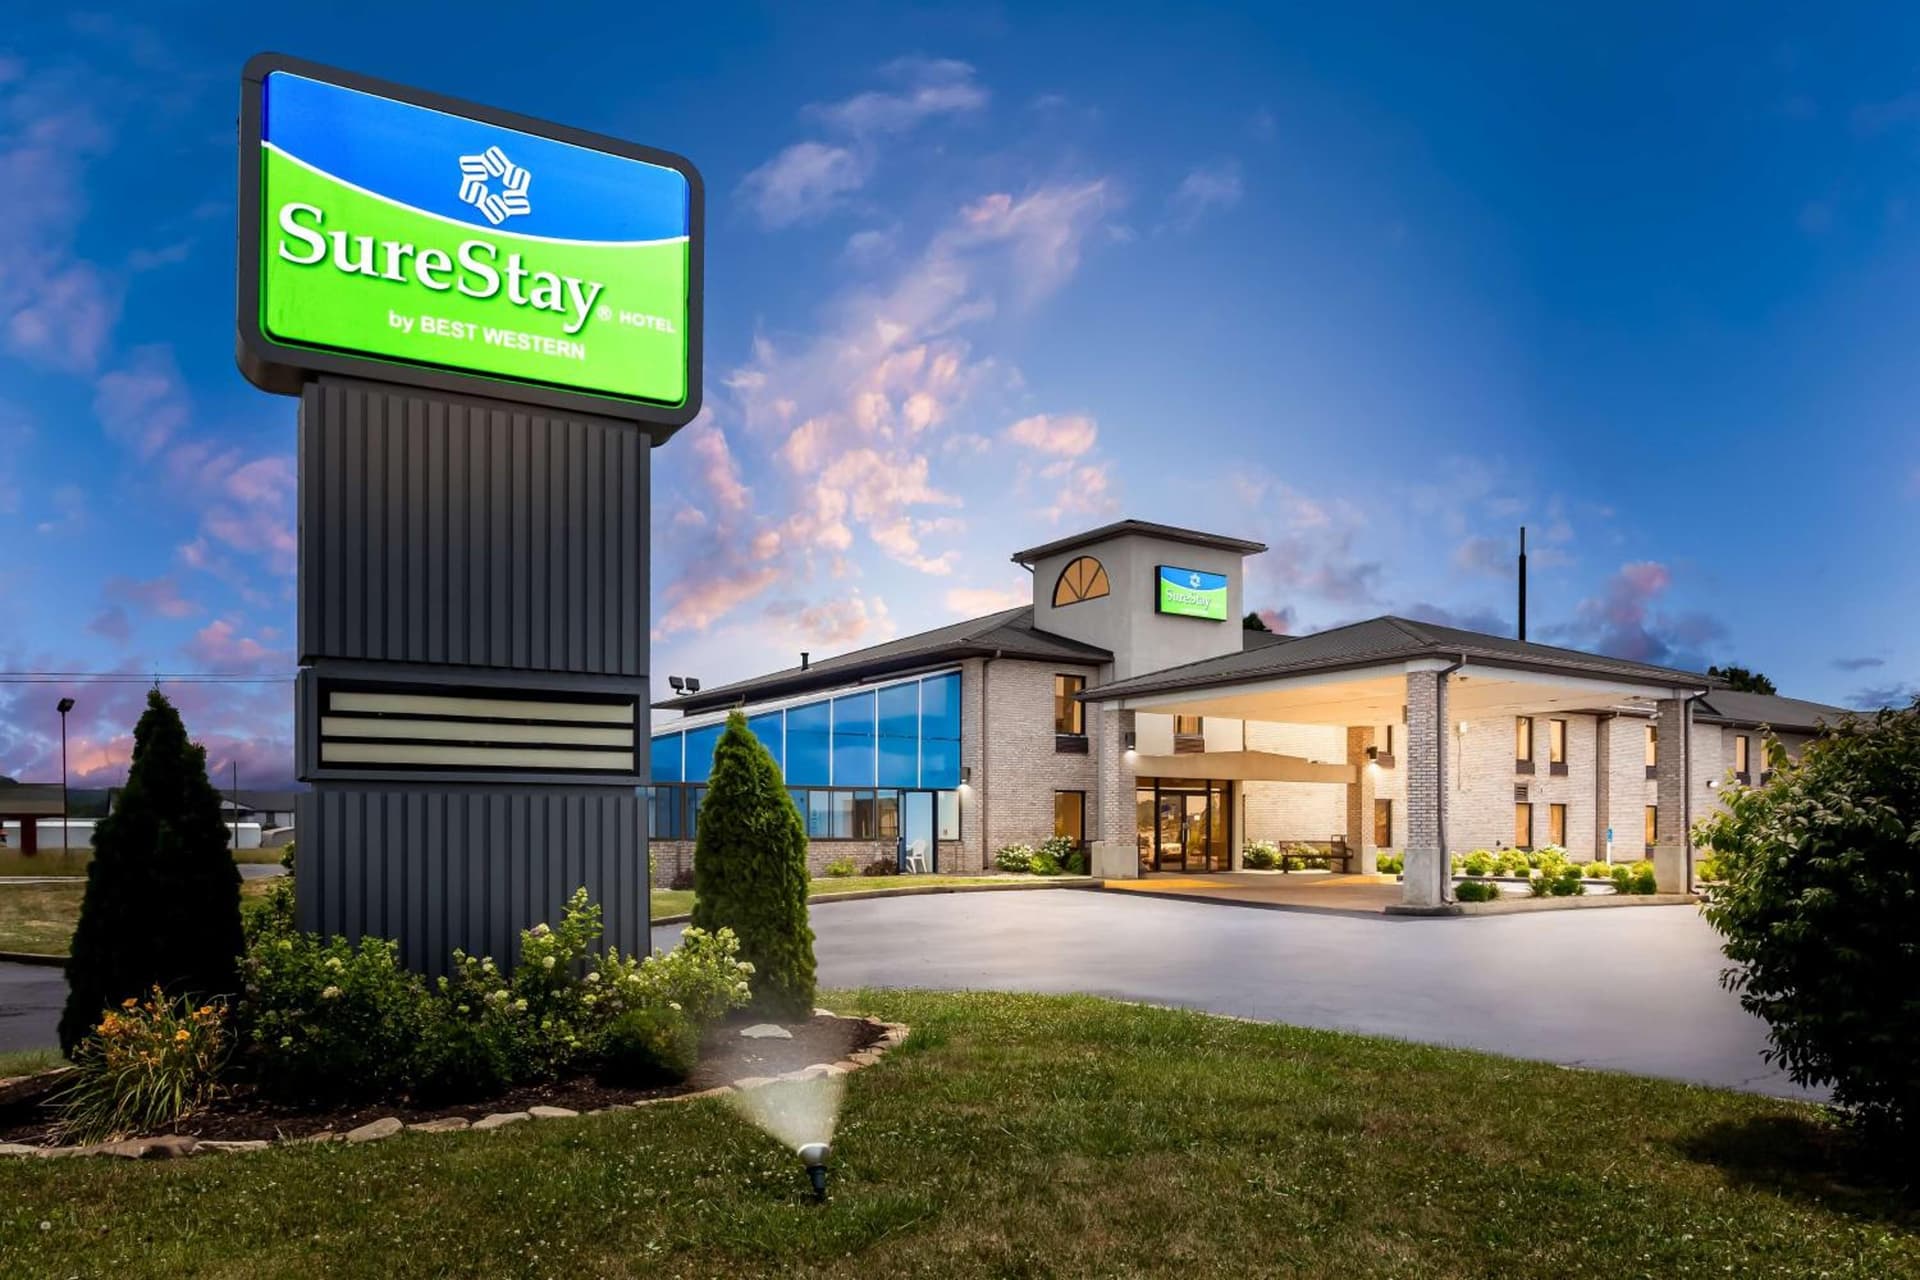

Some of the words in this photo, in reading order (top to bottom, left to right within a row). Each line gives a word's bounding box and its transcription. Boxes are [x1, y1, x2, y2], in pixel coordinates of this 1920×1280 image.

[388, 309, 414, 334] by
[420, 315, 478, 342] BEST
[482, 326, 586, 361] WESTERN
[619, 309, 677, 334] HOTEL
